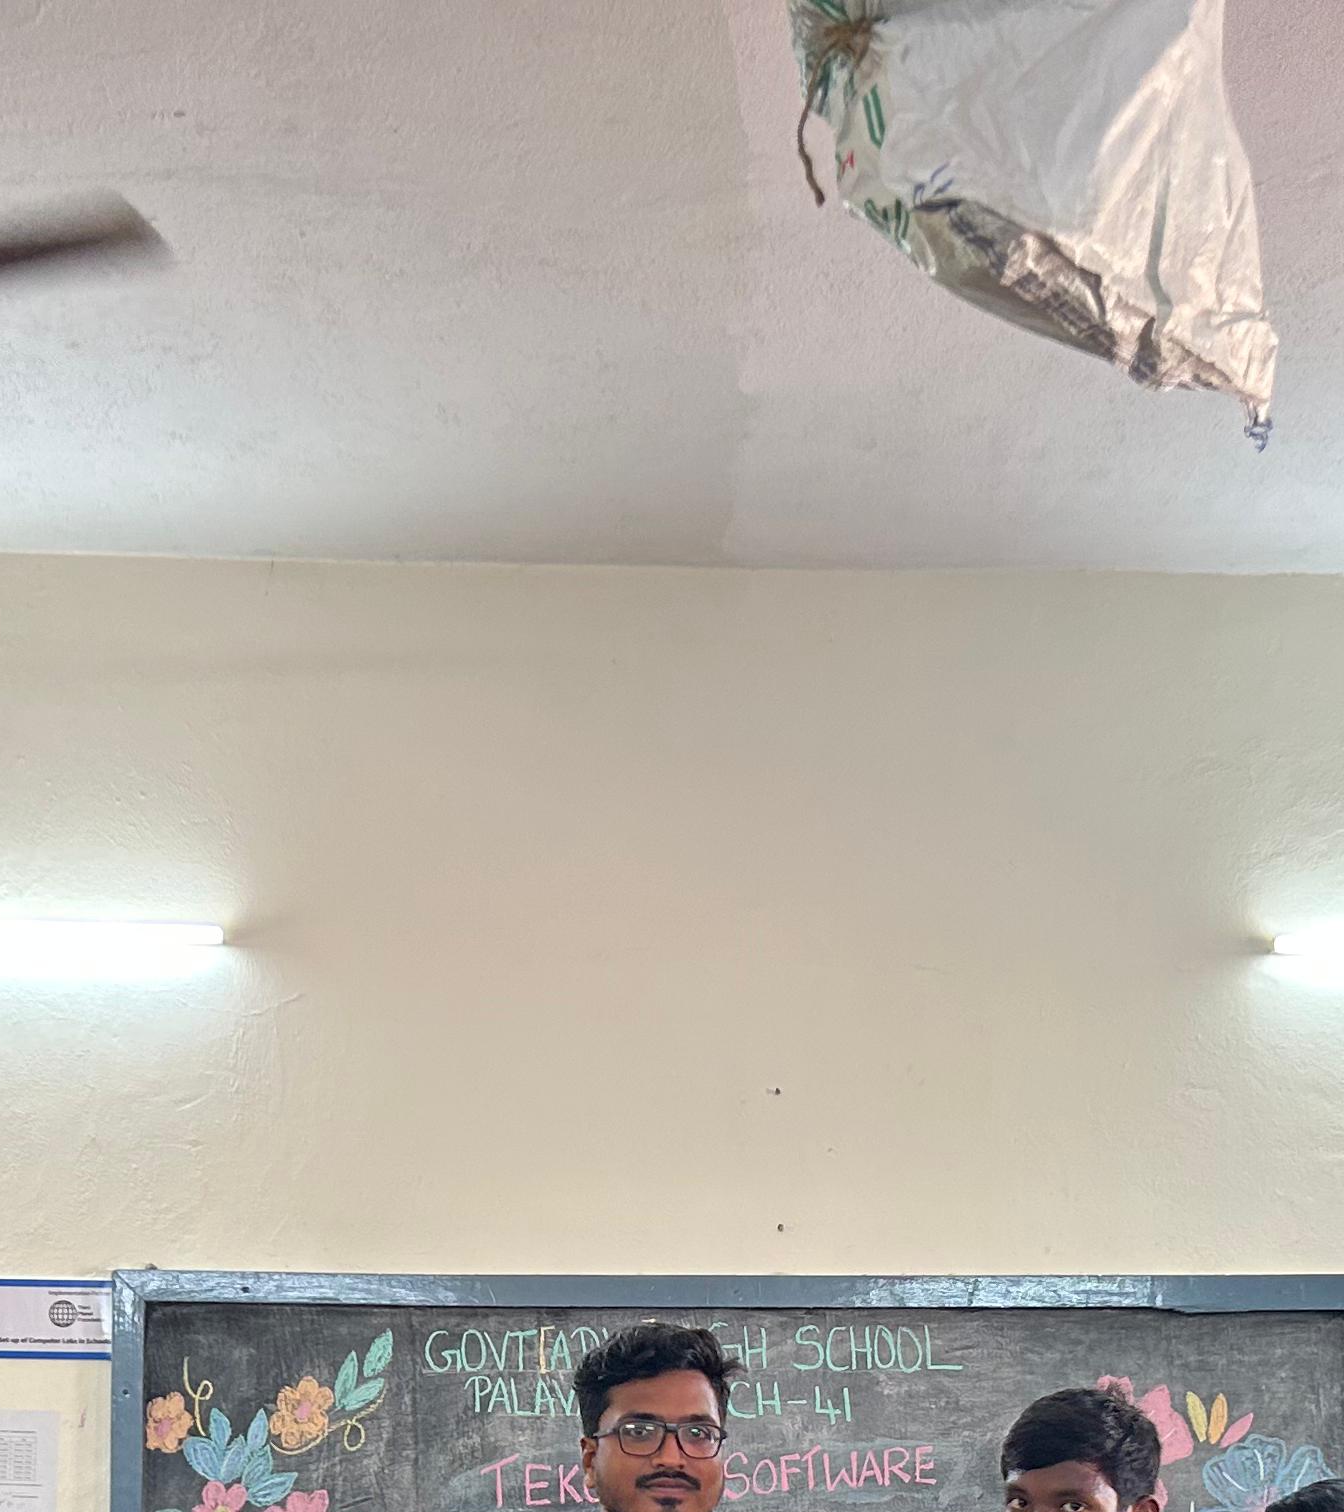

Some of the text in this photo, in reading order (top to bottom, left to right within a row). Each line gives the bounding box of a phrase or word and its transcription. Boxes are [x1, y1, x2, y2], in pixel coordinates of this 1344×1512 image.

[29, 1337, 61, 1345] Computer
[793, 1324, 964, 1373] SCHOOL
[464, 1375, 581, 1417] PALAV
[722, 1444, 938, 1500] SOFTWARE
